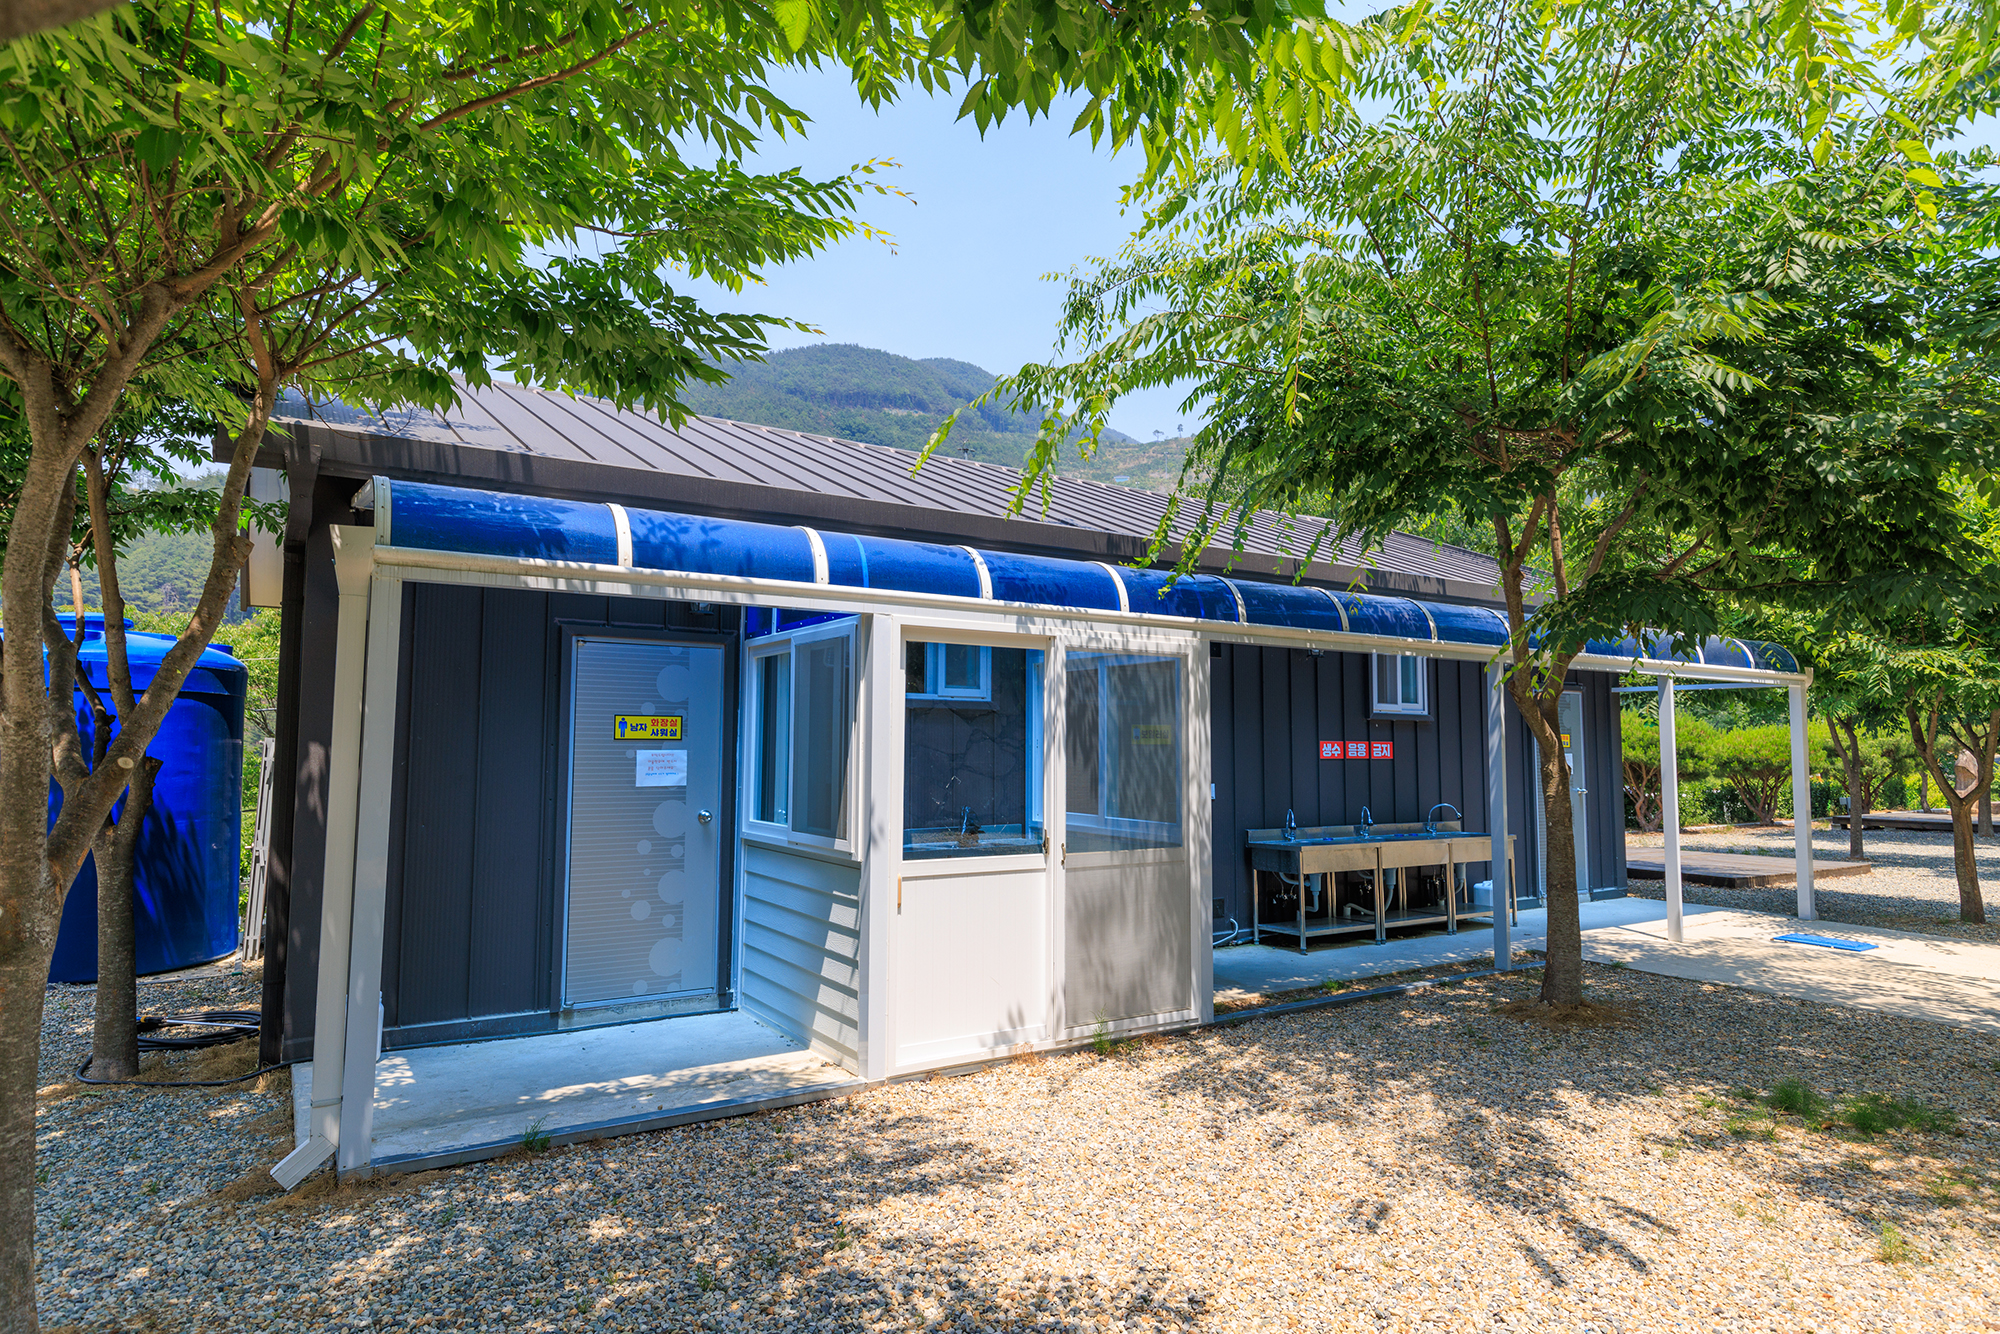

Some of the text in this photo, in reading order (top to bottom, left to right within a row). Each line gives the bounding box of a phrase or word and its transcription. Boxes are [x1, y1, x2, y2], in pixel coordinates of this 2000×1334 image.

[630, 718, 678, 732] 남자 화장실
[650, 728, 677, 737] 샤워실
[1322, 743, 1390, 757] 생수 음용 금지
